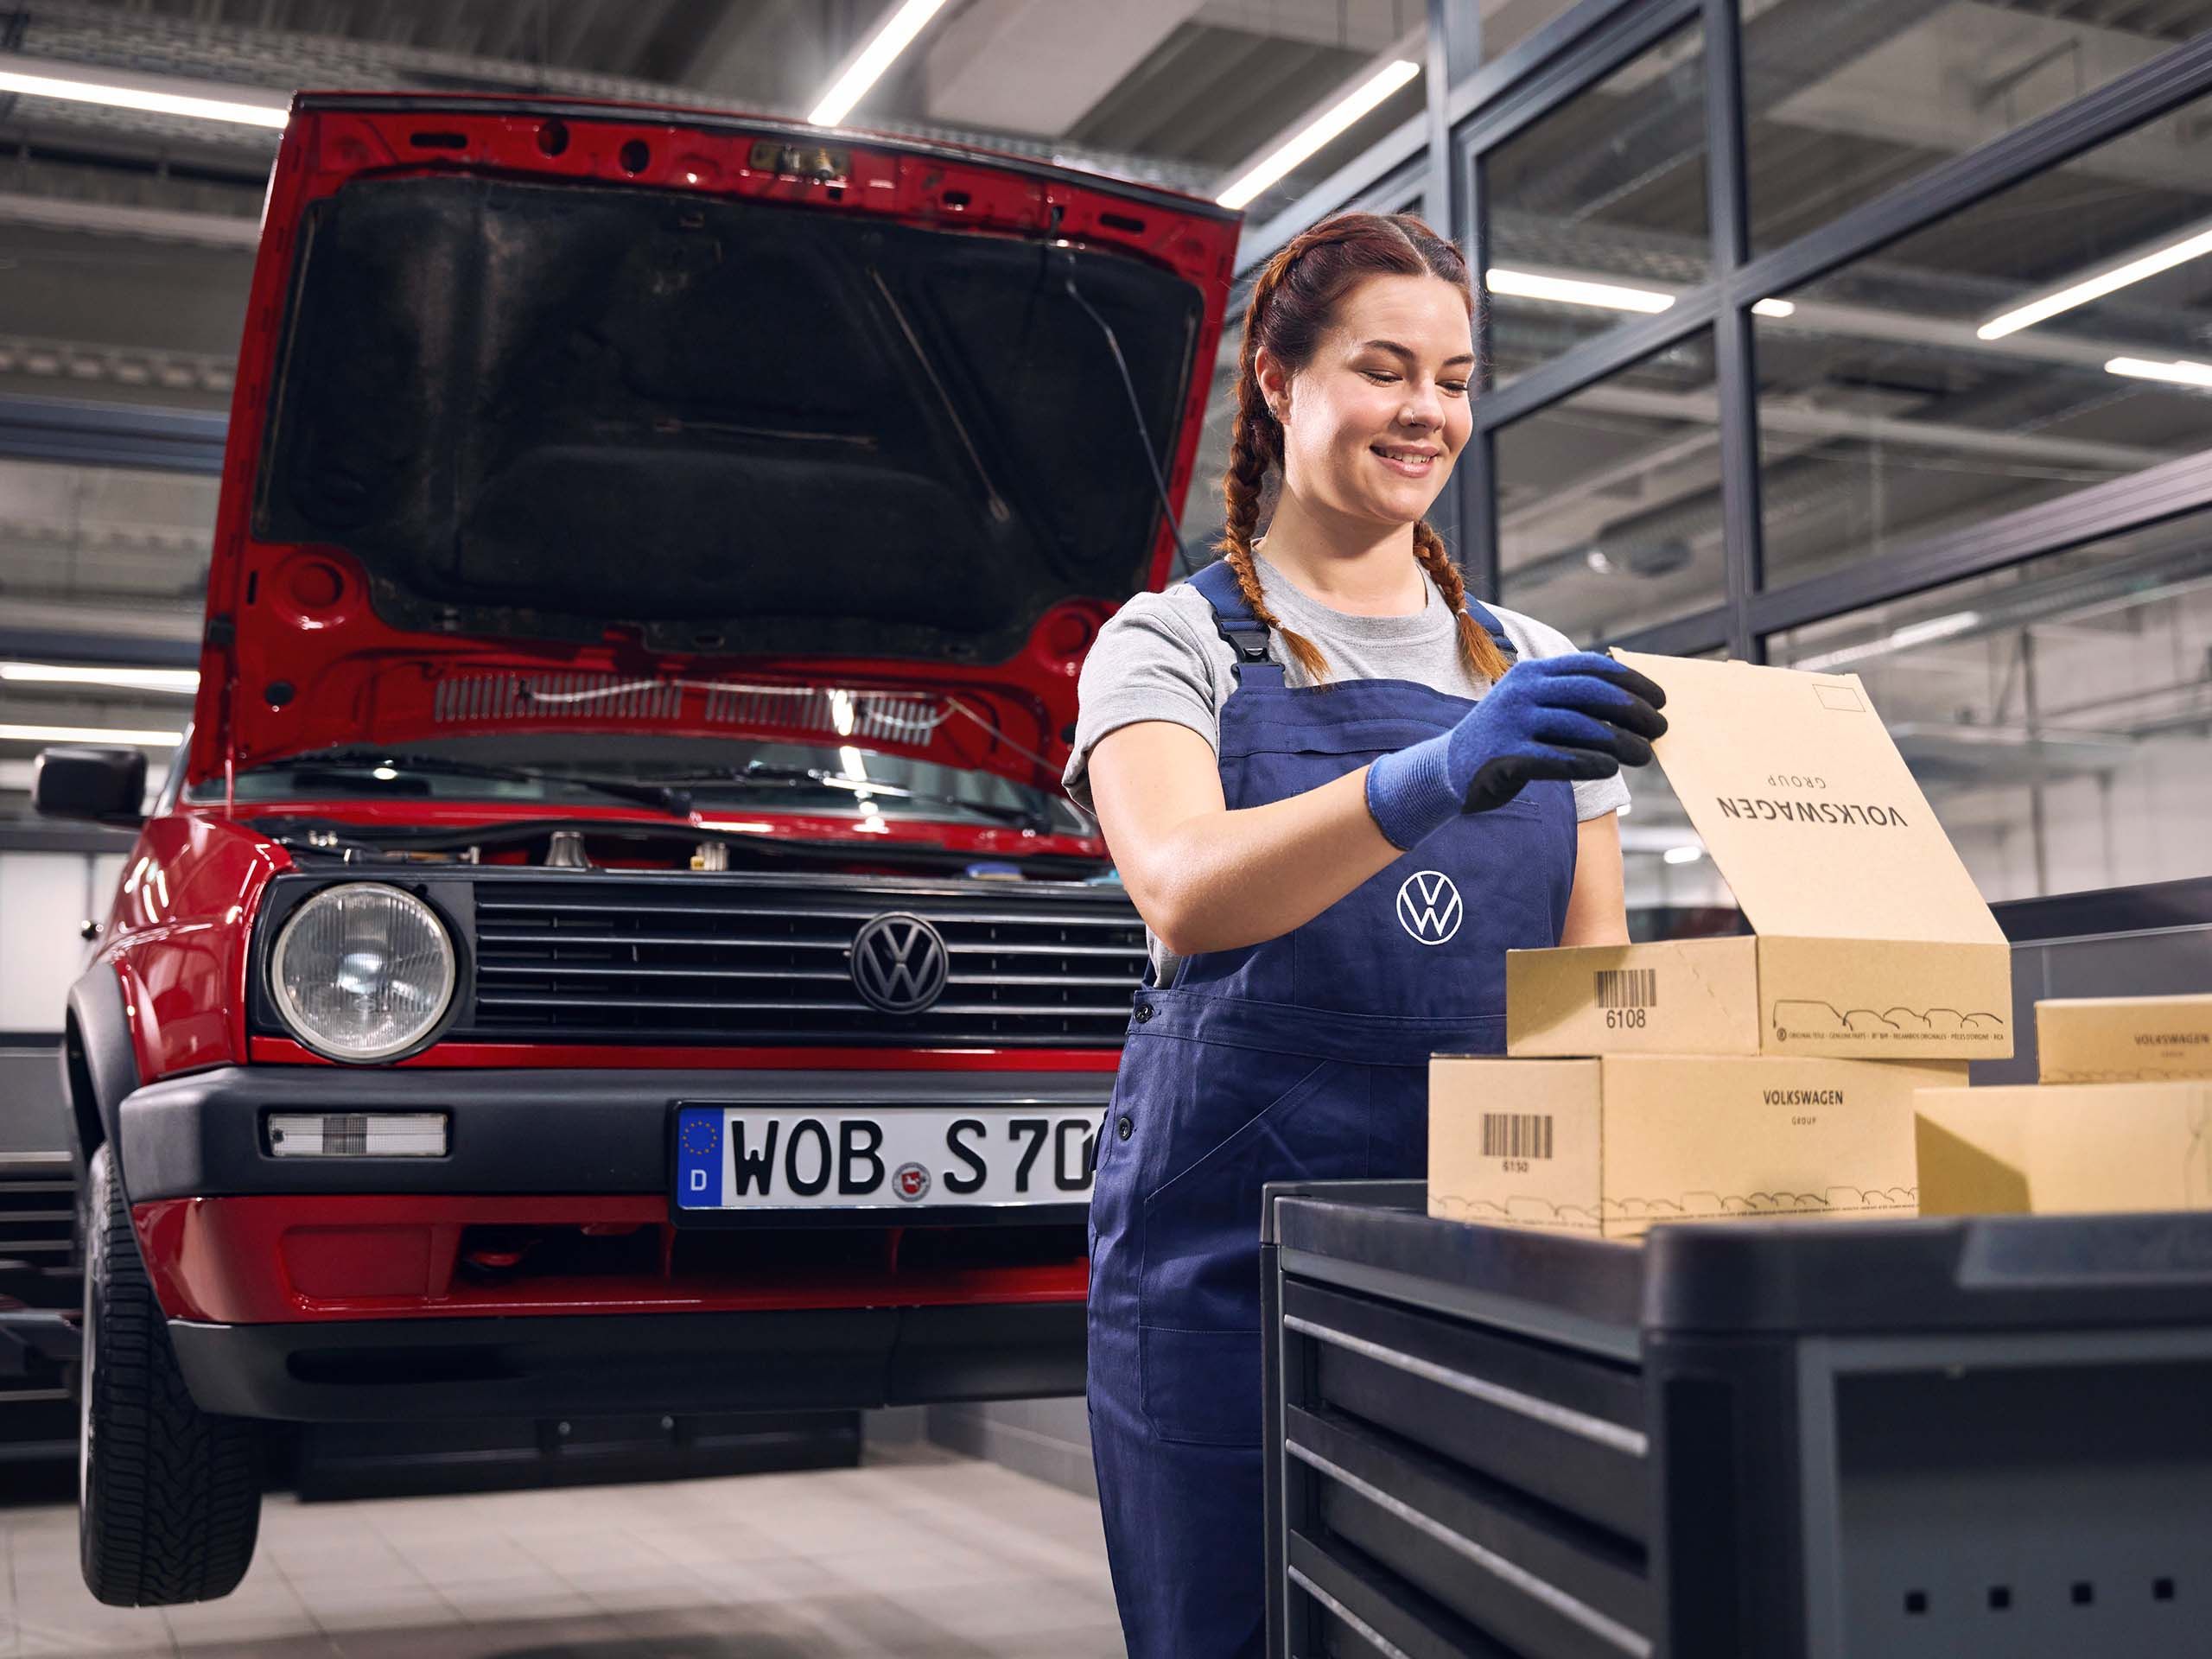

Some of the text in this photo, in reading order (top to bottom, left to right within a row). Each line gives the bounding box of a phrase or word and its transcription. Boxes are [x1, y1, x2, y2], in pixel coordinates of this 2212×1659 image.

[1768, 775, 1827, 789] GROUP
[1716, 797, 1909, 827] VOLKSWAGEN
[1606, 1008, 1646, 1028] 6108
[2134, 1033, 2209, 1045] VOLKSWAGEN
[1764, 1090, 1843, 1105] VOLKSWAGEN
[732, 1118, 885, 1197] WOB
[943, 1118, 988, 1195] S
[690, 1169, 707, 1191] D
